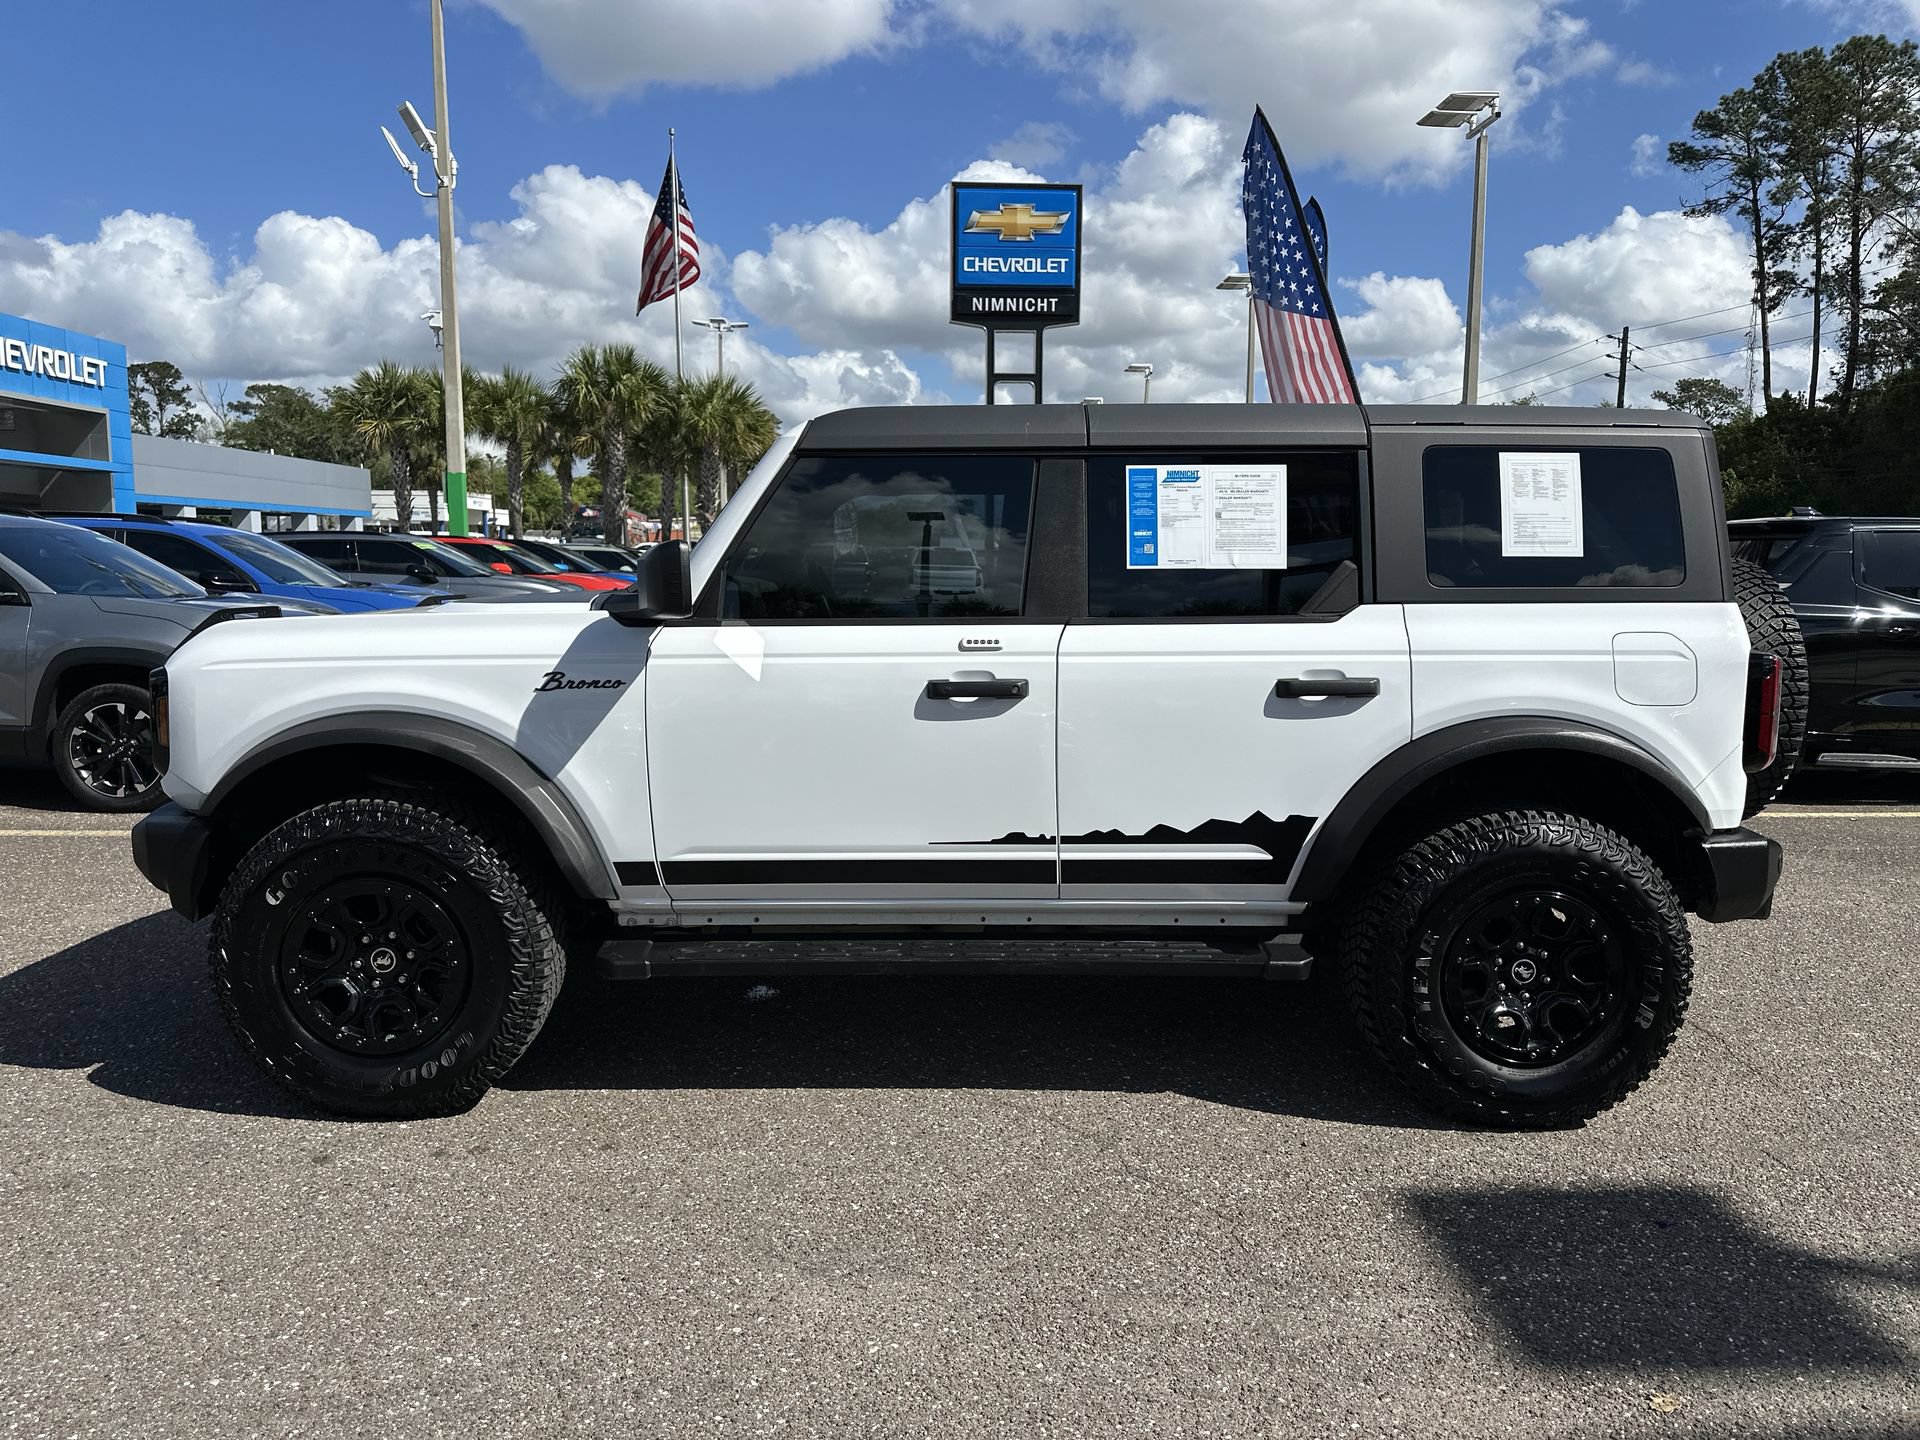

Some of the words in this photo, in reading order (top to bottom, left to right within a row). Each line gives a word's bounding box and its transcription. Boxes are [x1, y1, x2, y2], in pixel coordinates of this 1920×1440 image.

[963, 256, 1069, 273] CHEVROLET
[972, 297, 1059, 312] NIMNICHT
[533, 671, 626, 692] Bronco
[399, 1031, 475, 1088] GOOD
